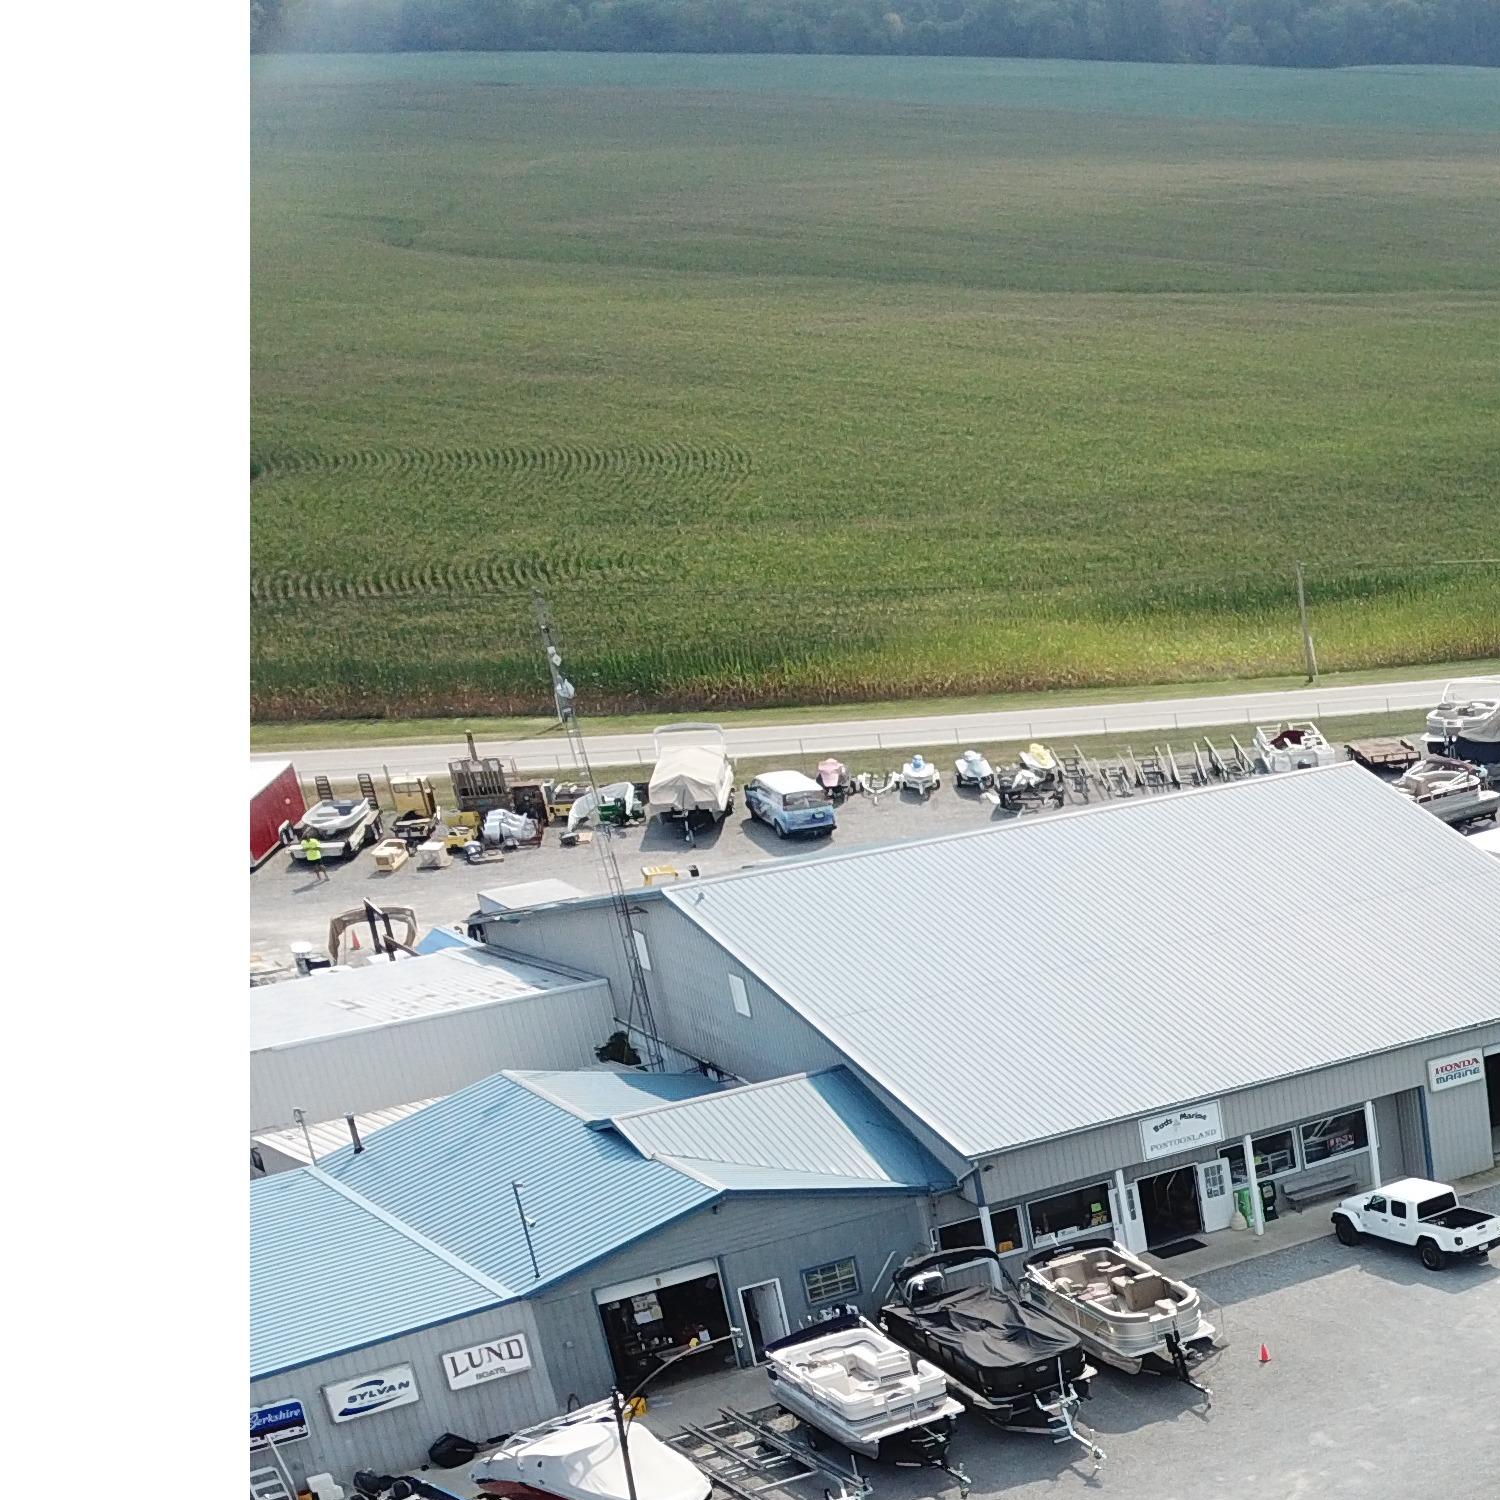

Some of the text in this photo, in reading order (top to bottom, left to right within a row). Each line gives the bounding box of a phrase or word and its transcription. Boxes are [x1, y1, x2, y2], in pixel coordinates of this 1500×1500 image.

[1435, 1057, 1480, 1075] HONDA
[1180, 1112, 1207, 1121] Marine
[1150, 1128, 1217, 1152] PONTOONLAND
[448, 1338, 524, 1379] LUND
[475, 1366, 507, 1380] BOATS
[347, 1380, 411, 1404] SYLVAN
